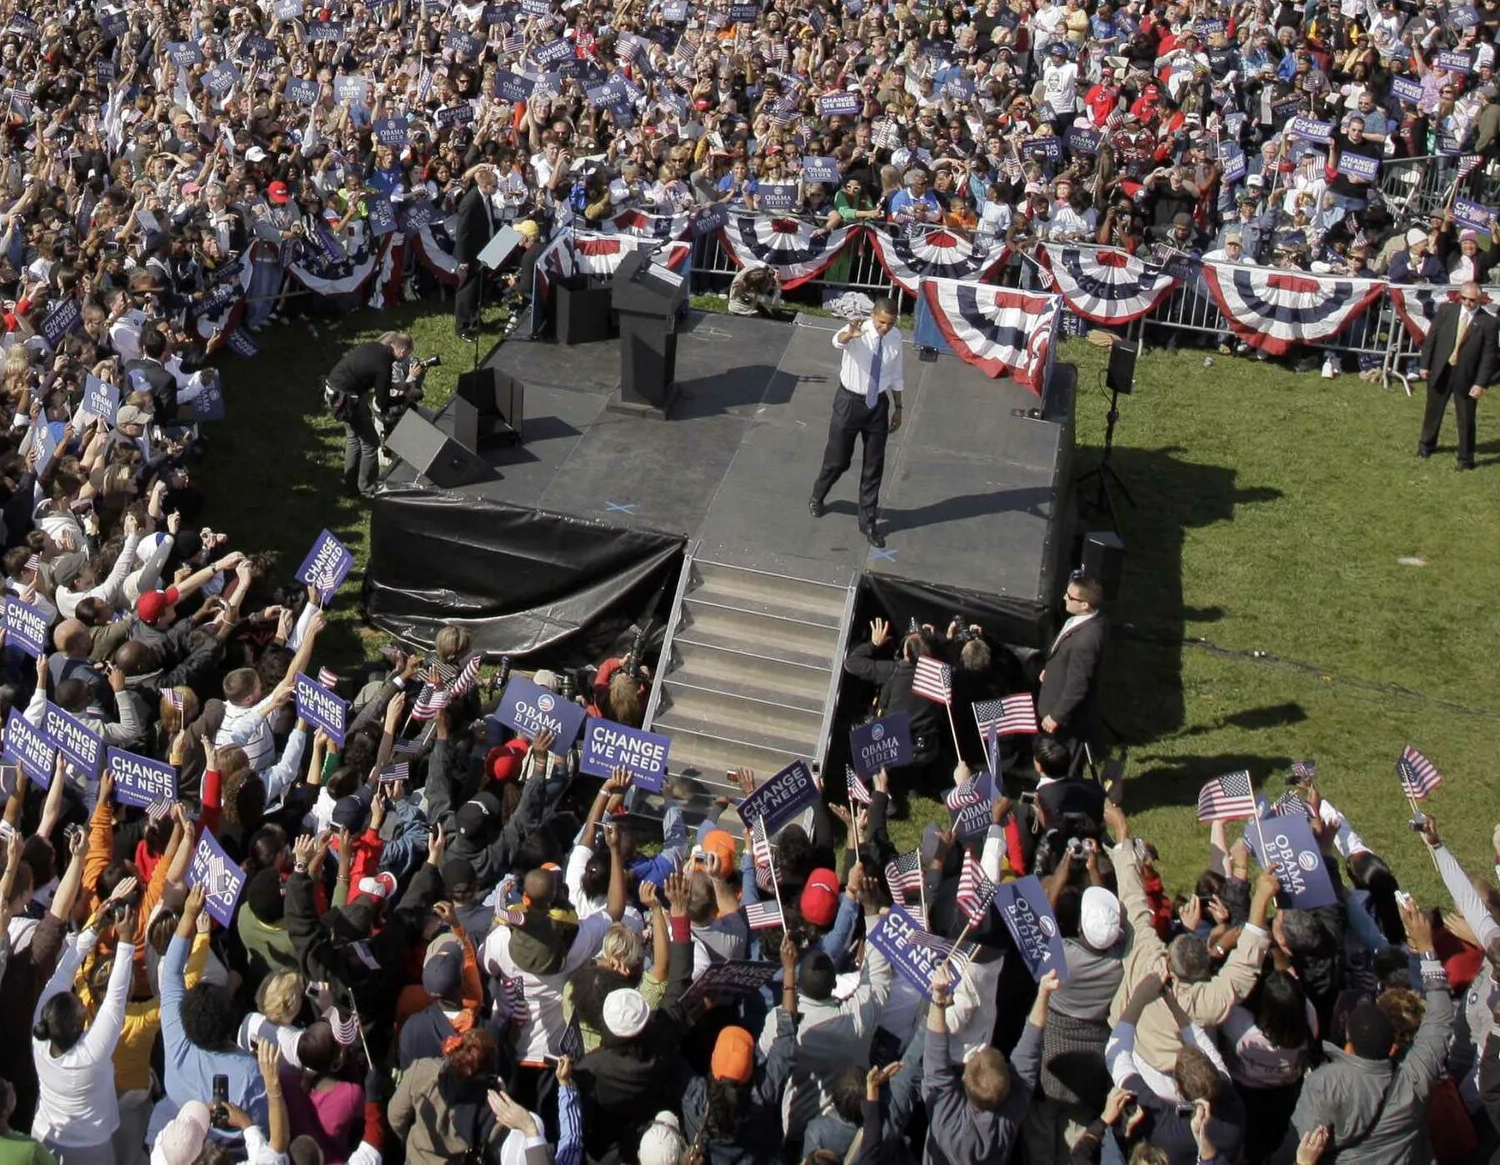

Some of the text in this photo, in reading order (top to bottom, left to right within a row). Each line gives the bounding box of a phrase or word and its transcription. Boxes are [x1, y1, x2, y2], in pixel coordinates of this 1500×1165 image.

[537, 42, 566, 60] CHANGE
[1440, 53, 1470, 63] CHANGE
[291, 86, 315, 98] OBAMA
[503, 82, 526, 94] OBAMA
[821, 96, 854, 105] CHANGE
[1393, 79, 1423, 94] CHANGE
[1295, 118, 1331, 133] CHANGE
[1341, 154, 1376, 170] CHANGE
[1353, 165, 1374, 174] NEED
[1454, 209, 1467, 219] WE
[45, 300, 75, 333] CHANGE
[91, 392, 113, 410] OBAMA
[304, 536, 338, 584] CHANGE
[324, 545, 343, 573] NEED
[6, 603, 47, 634] CHANGE
[6, 615, 44, 645] WE NEED
[297, 679, 343, 719] CHANGE
[298, 693, 342, 730] WE NEED
[47, 711, 98, 753] CHANGE
[515, 700, 563, 735] OBAMA
[8, 731, 52, 773] WE NEED
[9, 717, 55, 764] CHANGE
[47, 723, 97, 764] WE NEED
[591, 739, 615, 760] WE
[619, 749, 661, 773] NEED
[592, 726, 665, 762] CHANGE
[861, 736, 900, 759] OBAMA
[111, 756, 174, 789] CHANGE
[864, 748, 899, 770] BIDEN
[743, 767, 804, 818] CHANGE
[771, 777, 807, 808] NEED
[964, 812, 991, 833] BIDE
[193, 853, 234, 906] WE ND
[1274, 834, 1307, 895] OBAMA
[882, 921, 908, 950] WE
[1006, 904, 1040, 961] BIDEN
[1014, 897, 1052, 962] OBAMA
